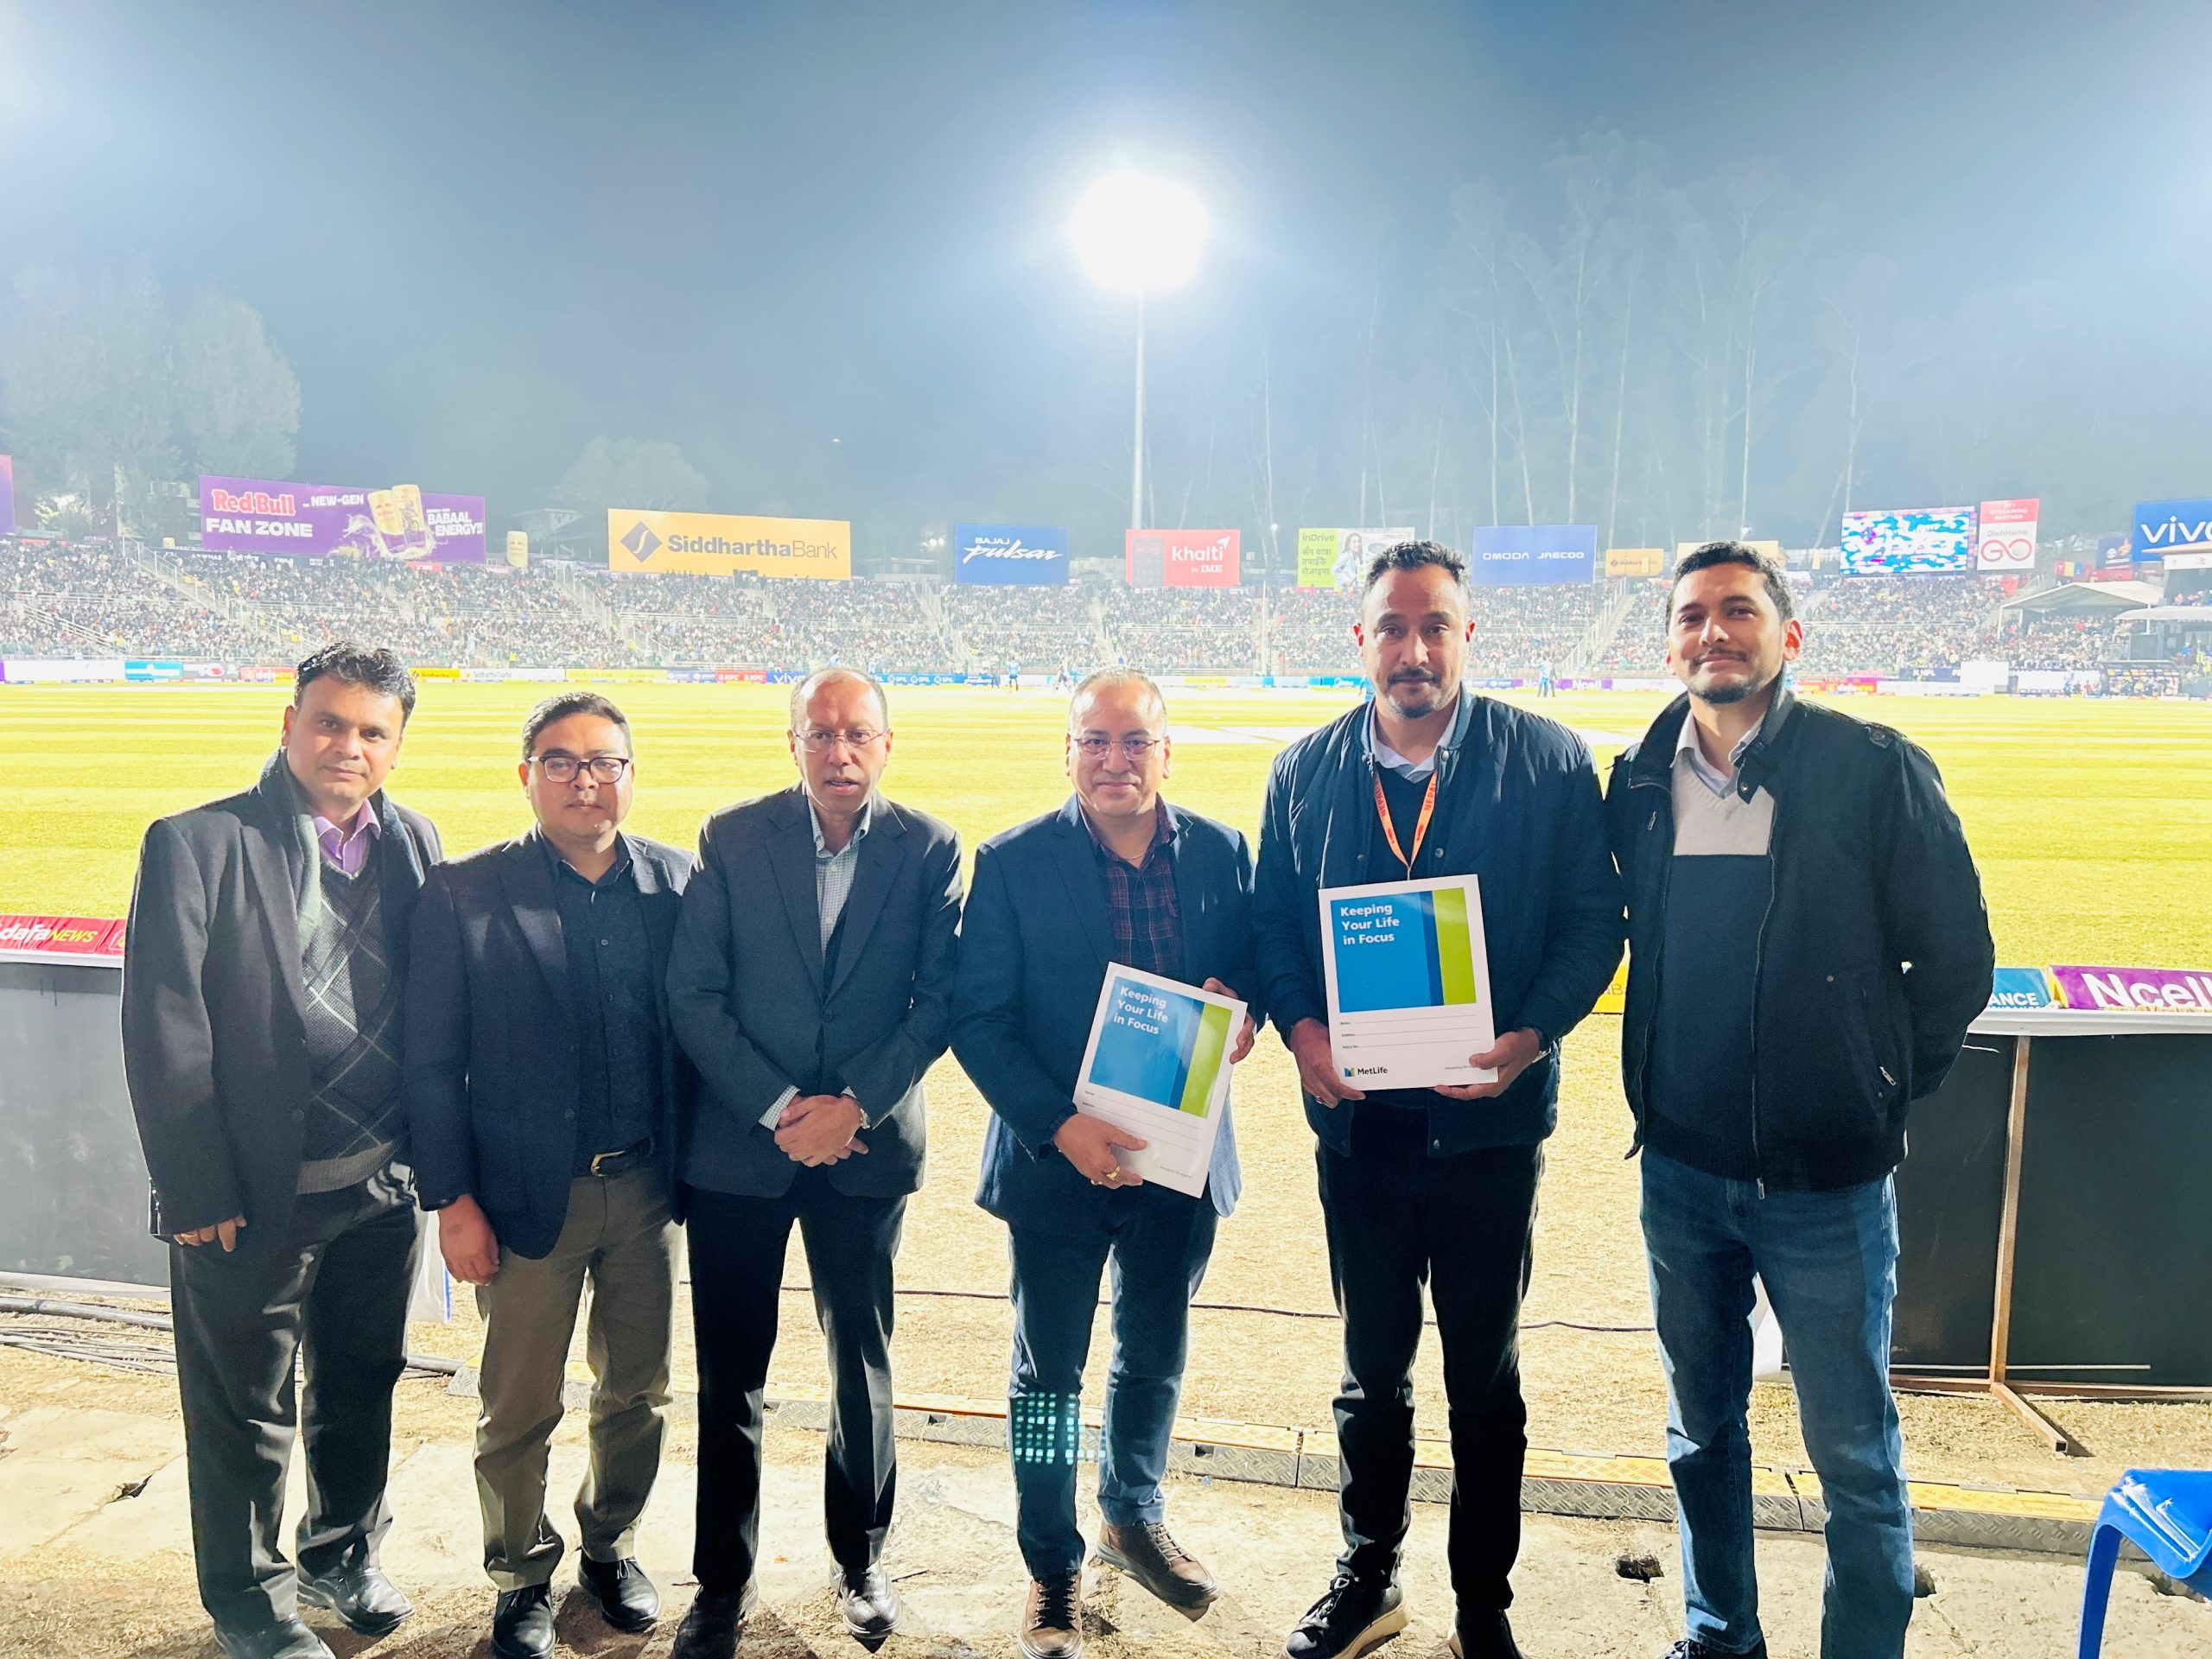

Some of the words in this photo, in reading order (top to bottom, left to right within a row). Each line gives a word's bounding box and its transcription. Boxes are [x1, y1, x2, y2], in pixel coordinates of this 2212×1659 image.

[212, 489, 254, 513] Red
[255, 493, 296, 517] Bull
[311, 494, 364, 507] NEW-GEN
[428, 512, 472, 524] BABAAL
[206, 518, 251, 535] FAN
[256, 521, 313, 537] ZONE
[435, 522, 483, 537] ENERGY!!
[1302, 533, 1335, 542] inDrive
[963, 539, 1063, 564] pulsar
[1172, 546, 1224, 562] khalti
[1201, 564, 1223, 573] IME
[1340, 904, 1393, 917] Keeping
[1342, 921, 1372, 931] Your
[1376, 917, 1400, 928] Life
[1343, 935, 1356, 945] in
[1358, 933, 1395, 944] Focus
[1121, 986, 1166, 1009] Keeping
[1987, 992, 2039, 1006] ANCE
[1118, 999, 1145, 1015] Your
[1147, 1008, 1168, 1023] Life
[1114, 1013, 1125, 1025] in
[1127, 1017, 1160, 1034] Focus
